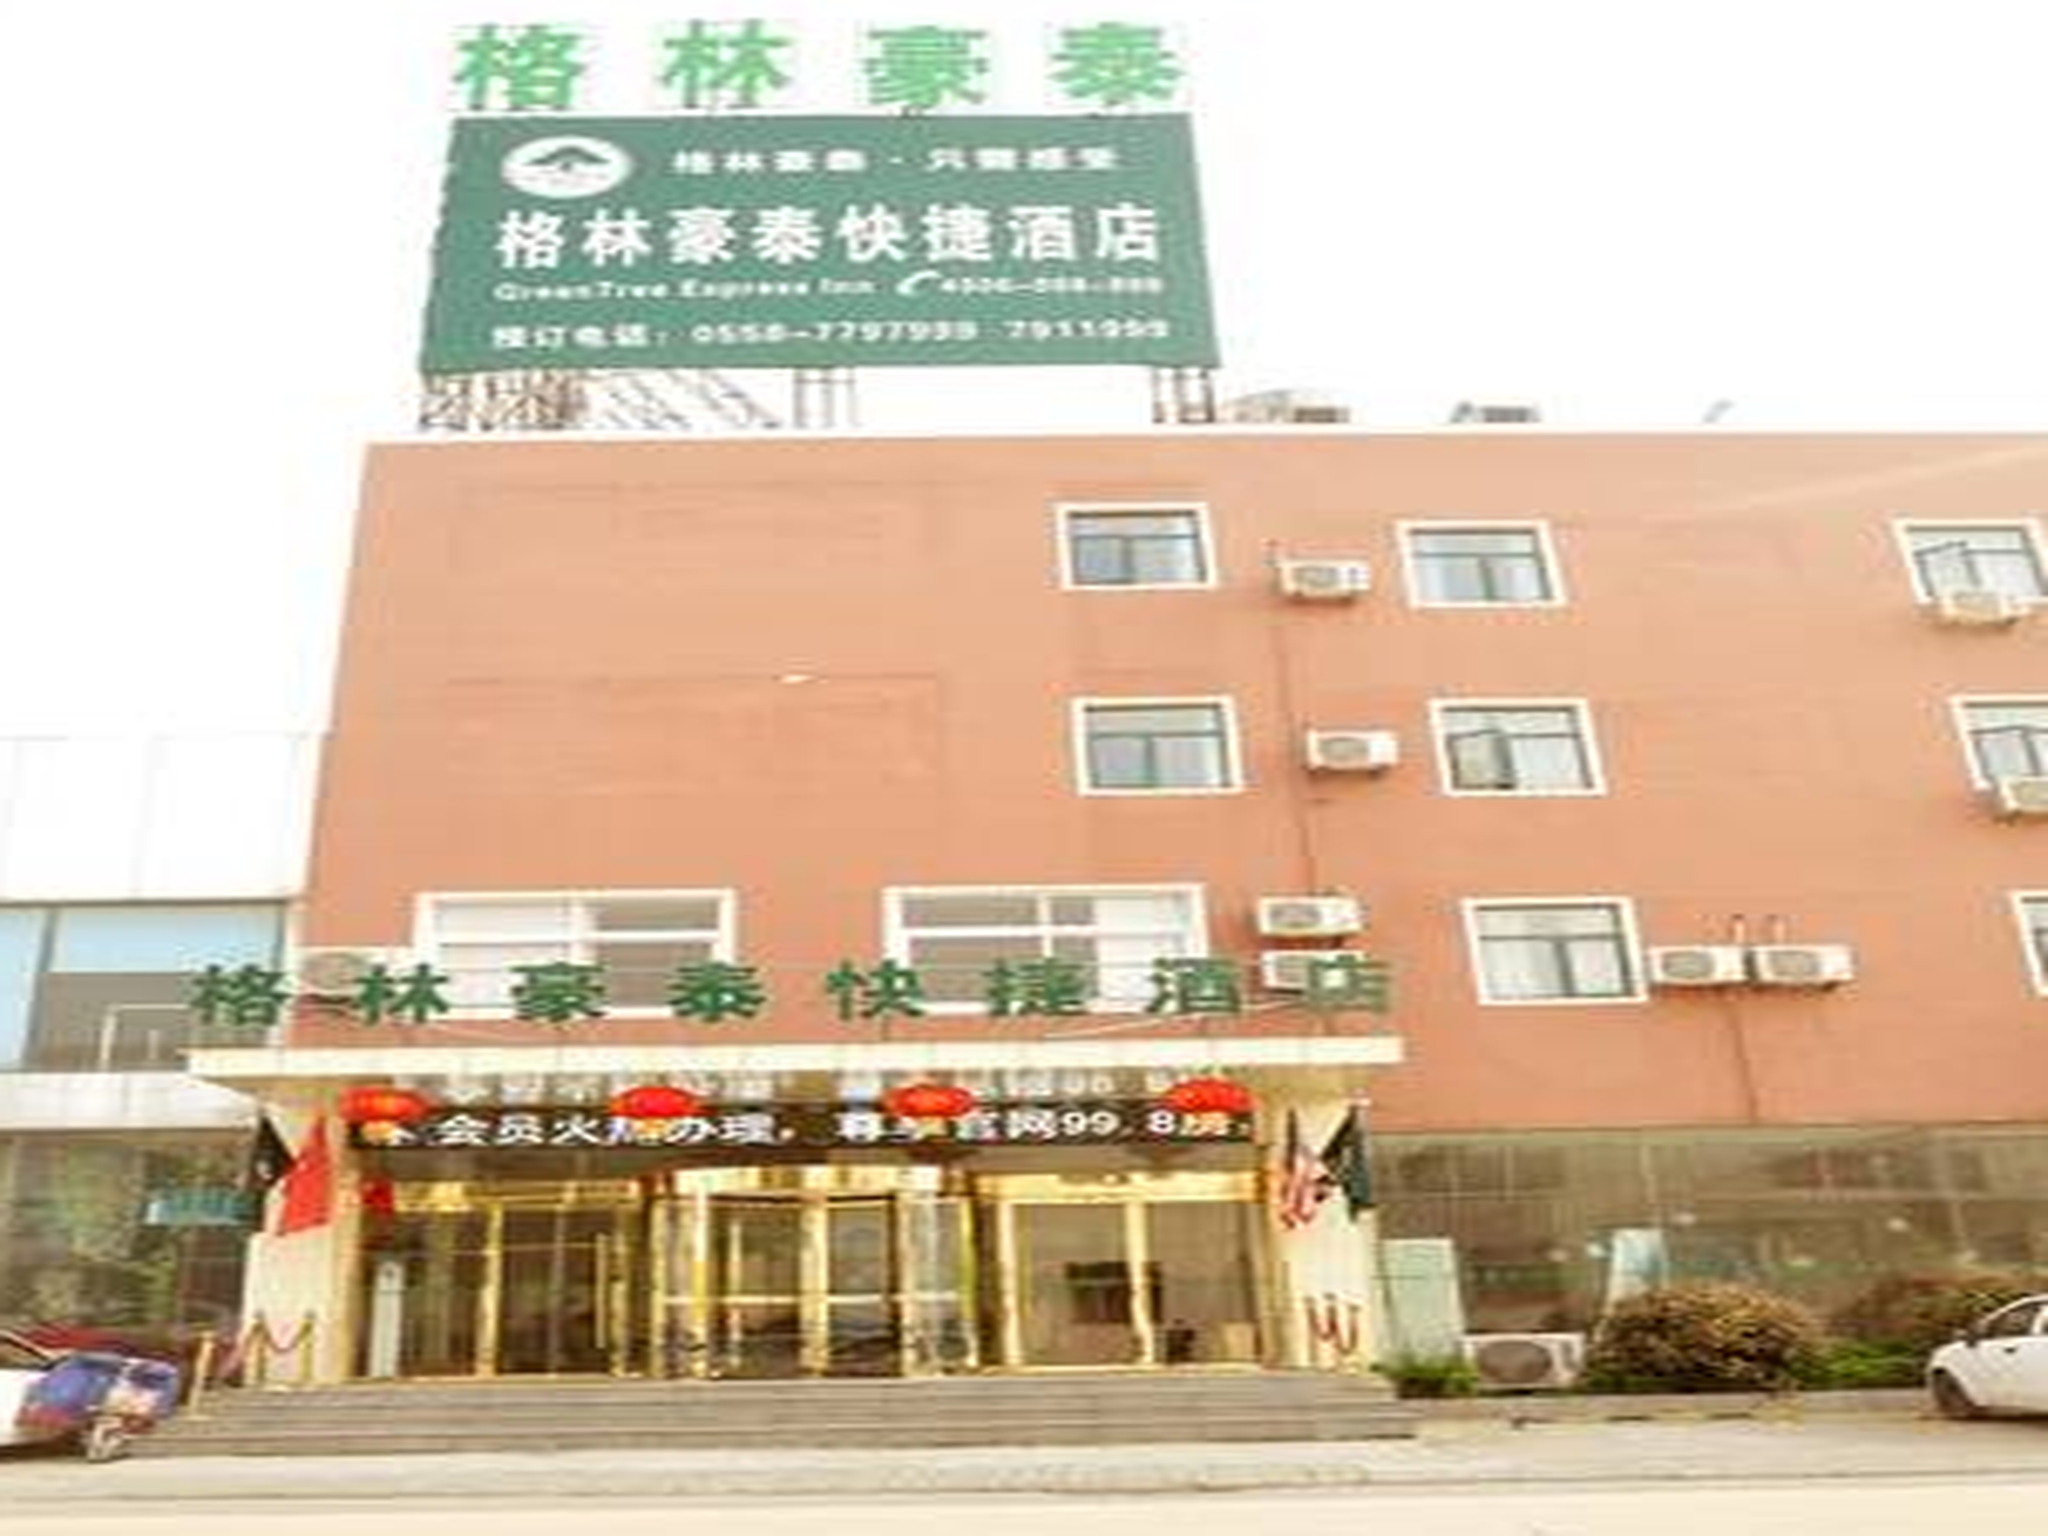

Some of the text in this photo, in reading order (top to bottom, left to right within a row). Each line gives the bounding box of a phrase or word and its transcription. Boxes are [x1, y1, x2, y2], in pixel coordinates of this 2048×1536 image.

[453, 22, 1187, 108] 格林豪泰
[495, 202, 1162, 270] 格林豪泰快捷酒店
[494, 278, 669, 301] GreenTree
[680, 277, 810, 300] Express
[193, 957, 1392, 1026] 格林豪泰快捷酒店
